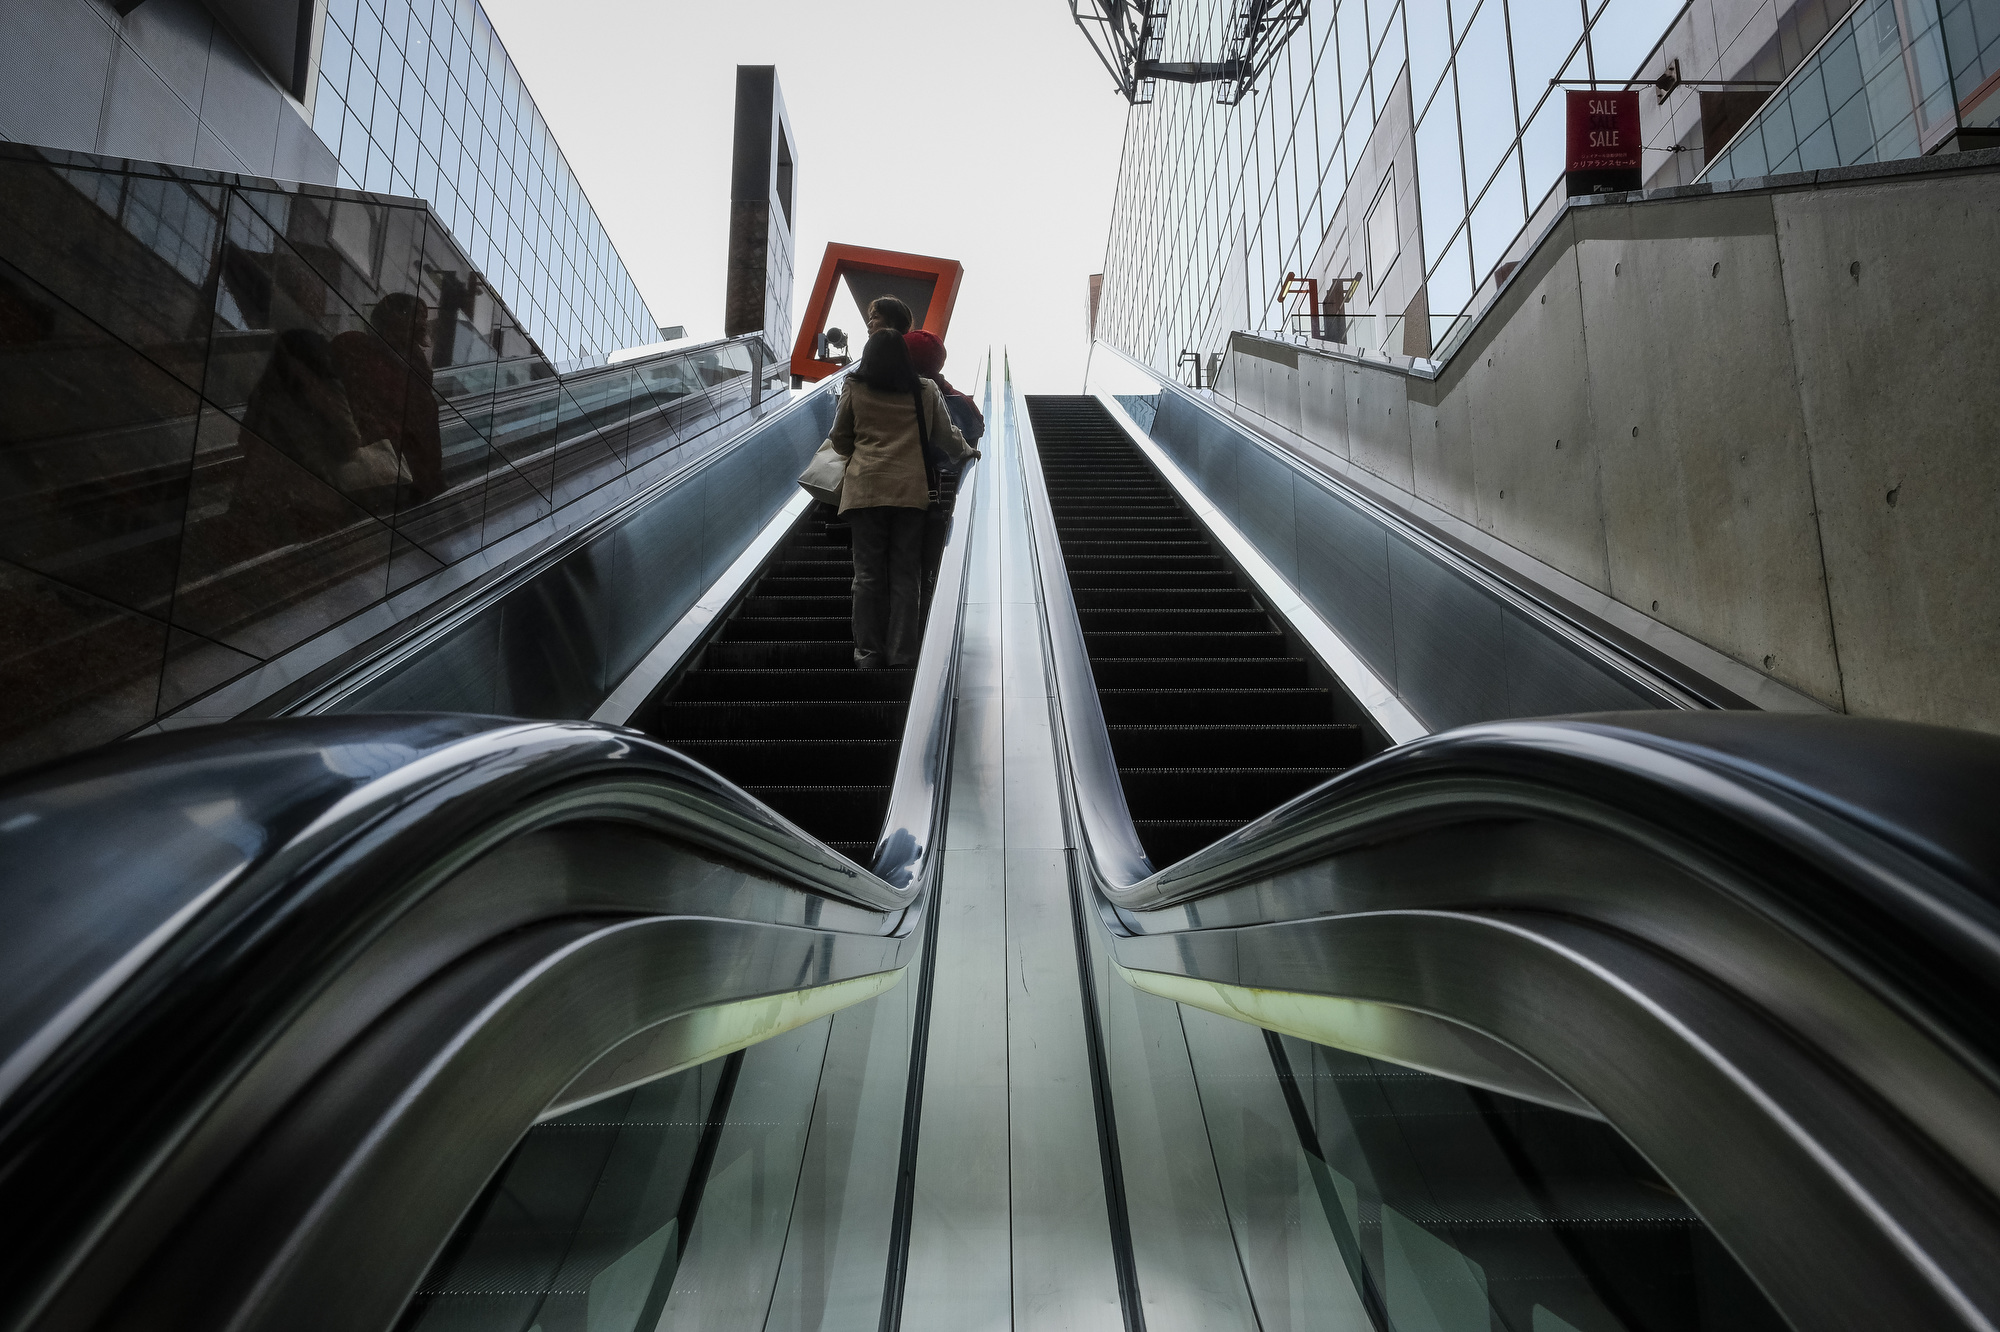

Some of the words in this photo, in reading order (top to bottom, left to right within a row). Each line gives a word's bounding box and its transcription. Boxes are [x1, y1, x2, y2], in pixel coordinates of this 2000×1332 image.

[1589, 99, 1617, 115] SALE
[1589, 130, 1619, 147] SALE
[1573, 160, 1636, 169] クリアランスセール
